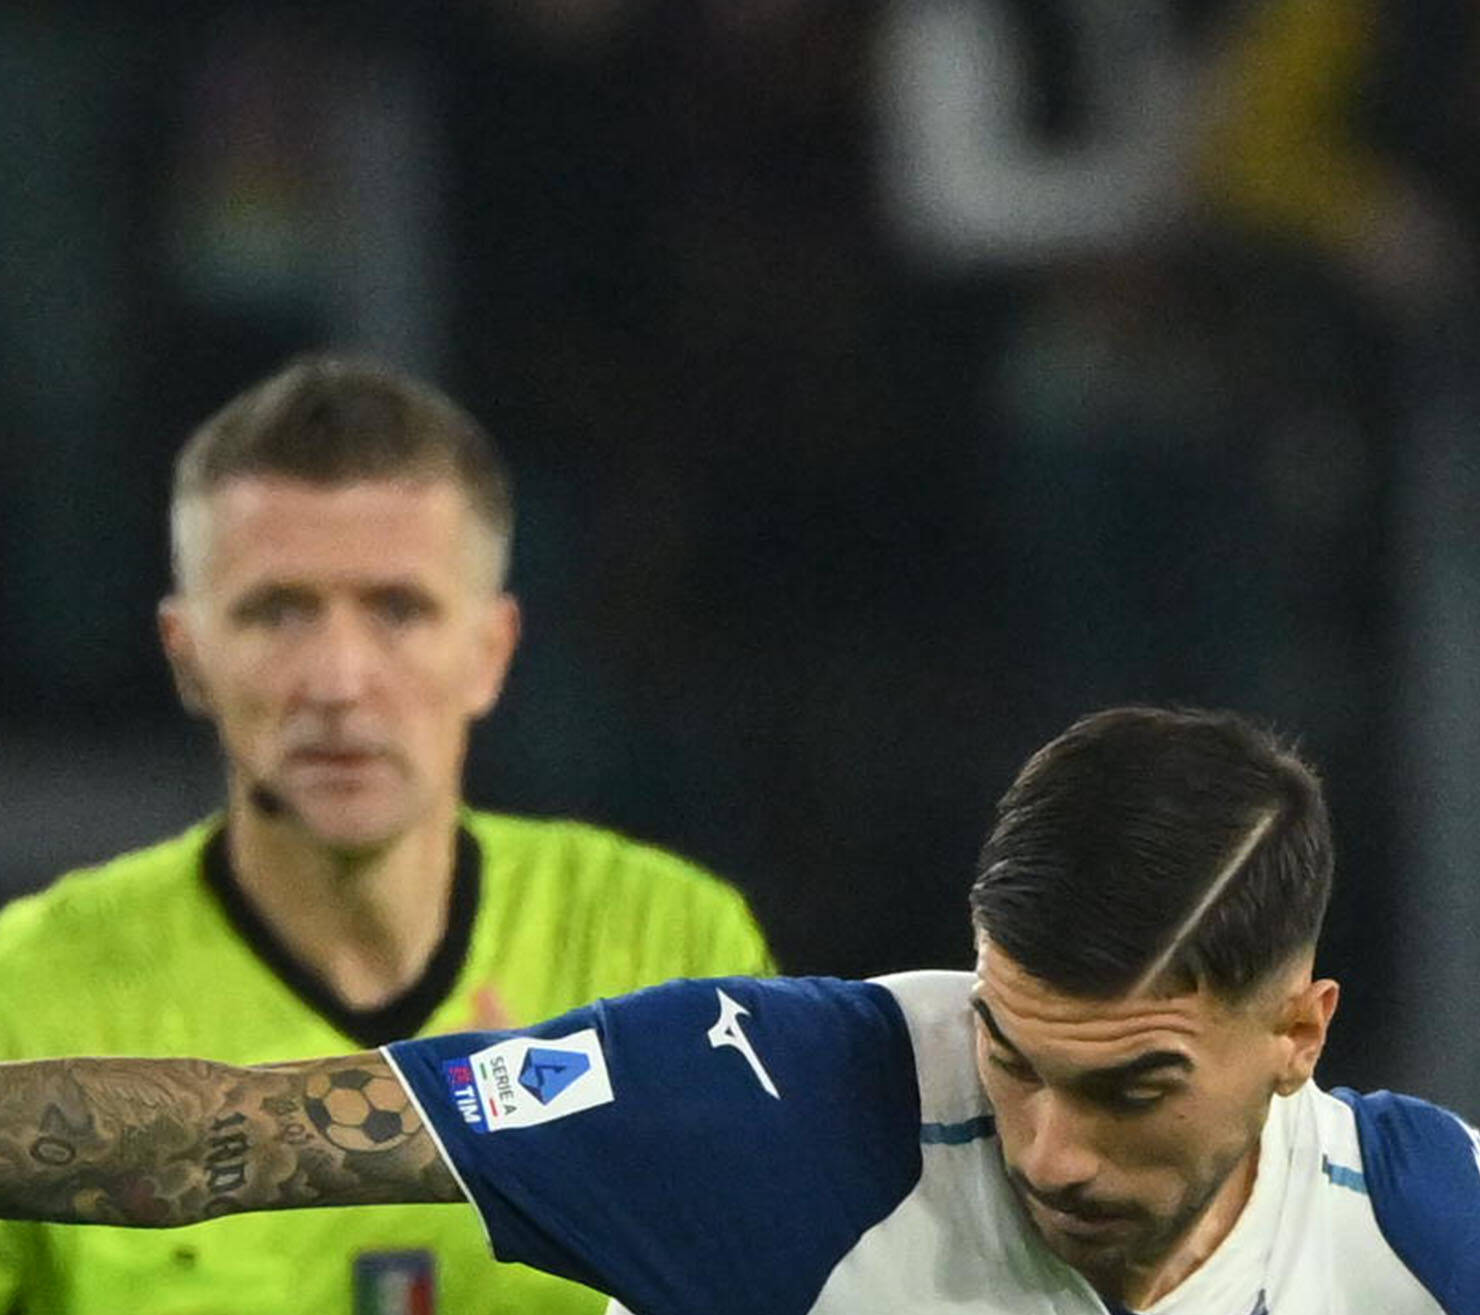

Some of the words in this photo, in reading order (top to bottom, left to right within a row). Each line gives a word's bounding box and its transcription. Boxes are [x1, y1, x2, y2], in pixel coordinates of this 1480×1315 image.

[490, 1056, 515, 1101] SERIE
[453, 1084, 482, 1124] TIM
[502, 1103, 518, 1115] A
